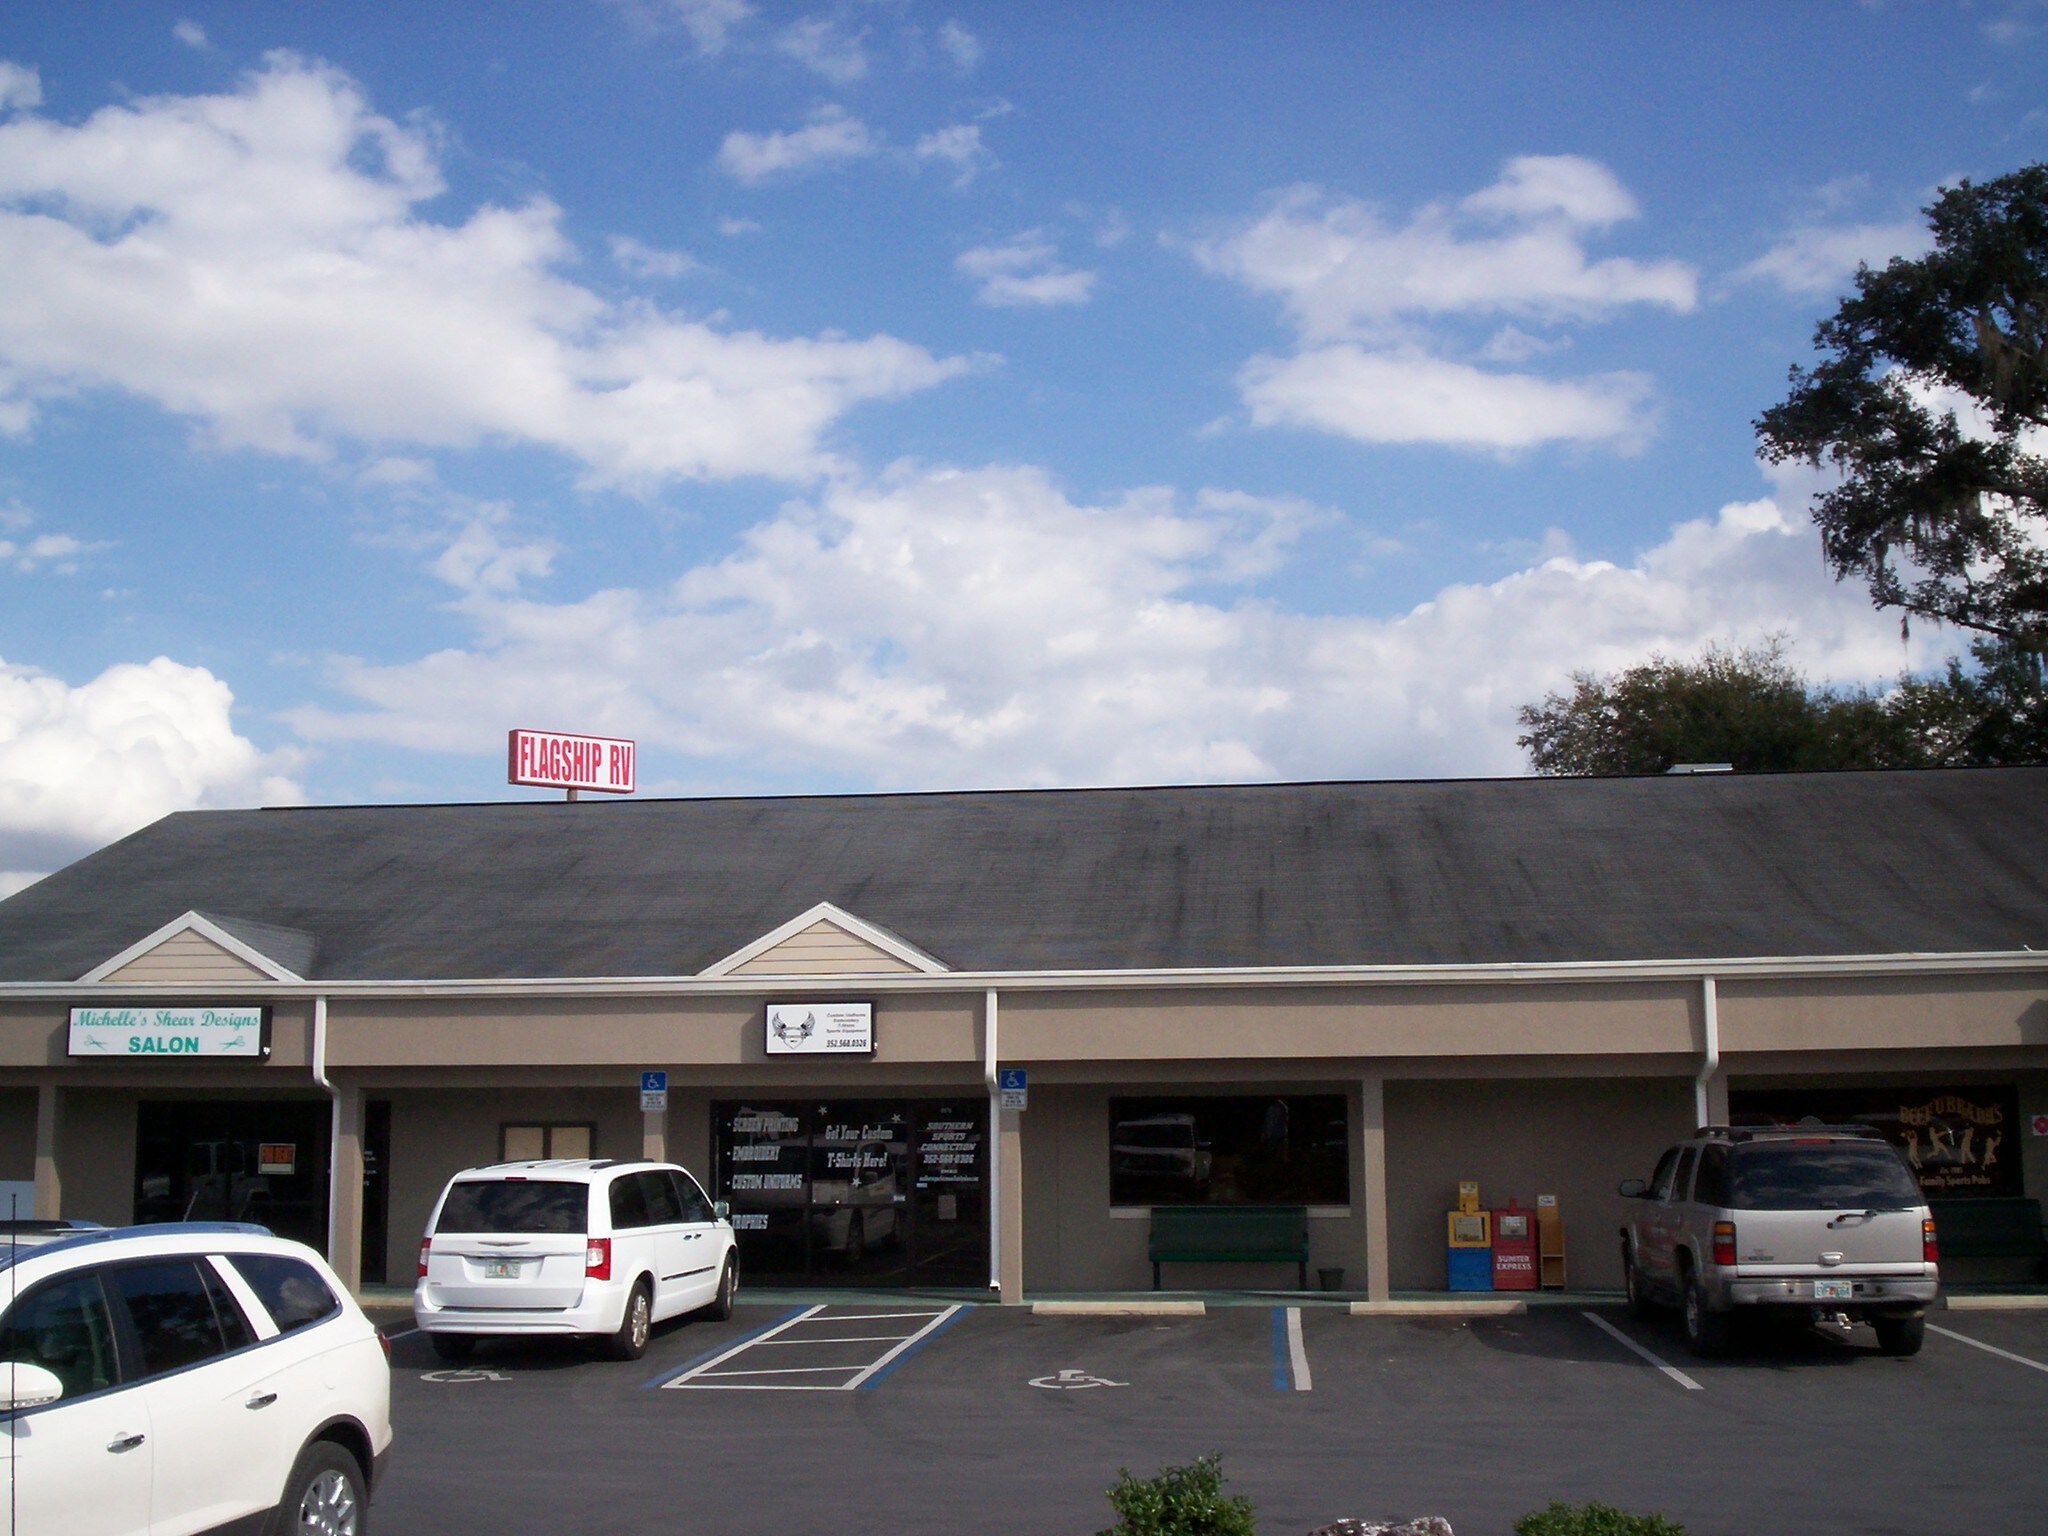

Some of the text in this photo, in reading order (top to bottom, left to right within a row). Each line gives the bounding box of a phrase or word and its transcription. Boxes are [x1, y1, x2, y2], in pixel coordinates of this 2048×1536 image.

[520, 736, 631, 785] FLAGSHIP RV
[73, 1010, 258, 1030] Michelle's Shear Designs
[128, 1036, 199, 1053] SALON
[825, 1124, 893, 1140] Get Your Custom
[926, 1122, 974, 1130] SOUTHERN
[931, 1132, 966, 1141] SPORTS
[920, 1143, 976, 1151] CONNECTION
[827, 1152, 888, 1168] T-Shirts Here!
[732, 1174, 802, 1189] CUSTOM UNIFORMS
[1946, 1175, 1971, 1187] Sports
